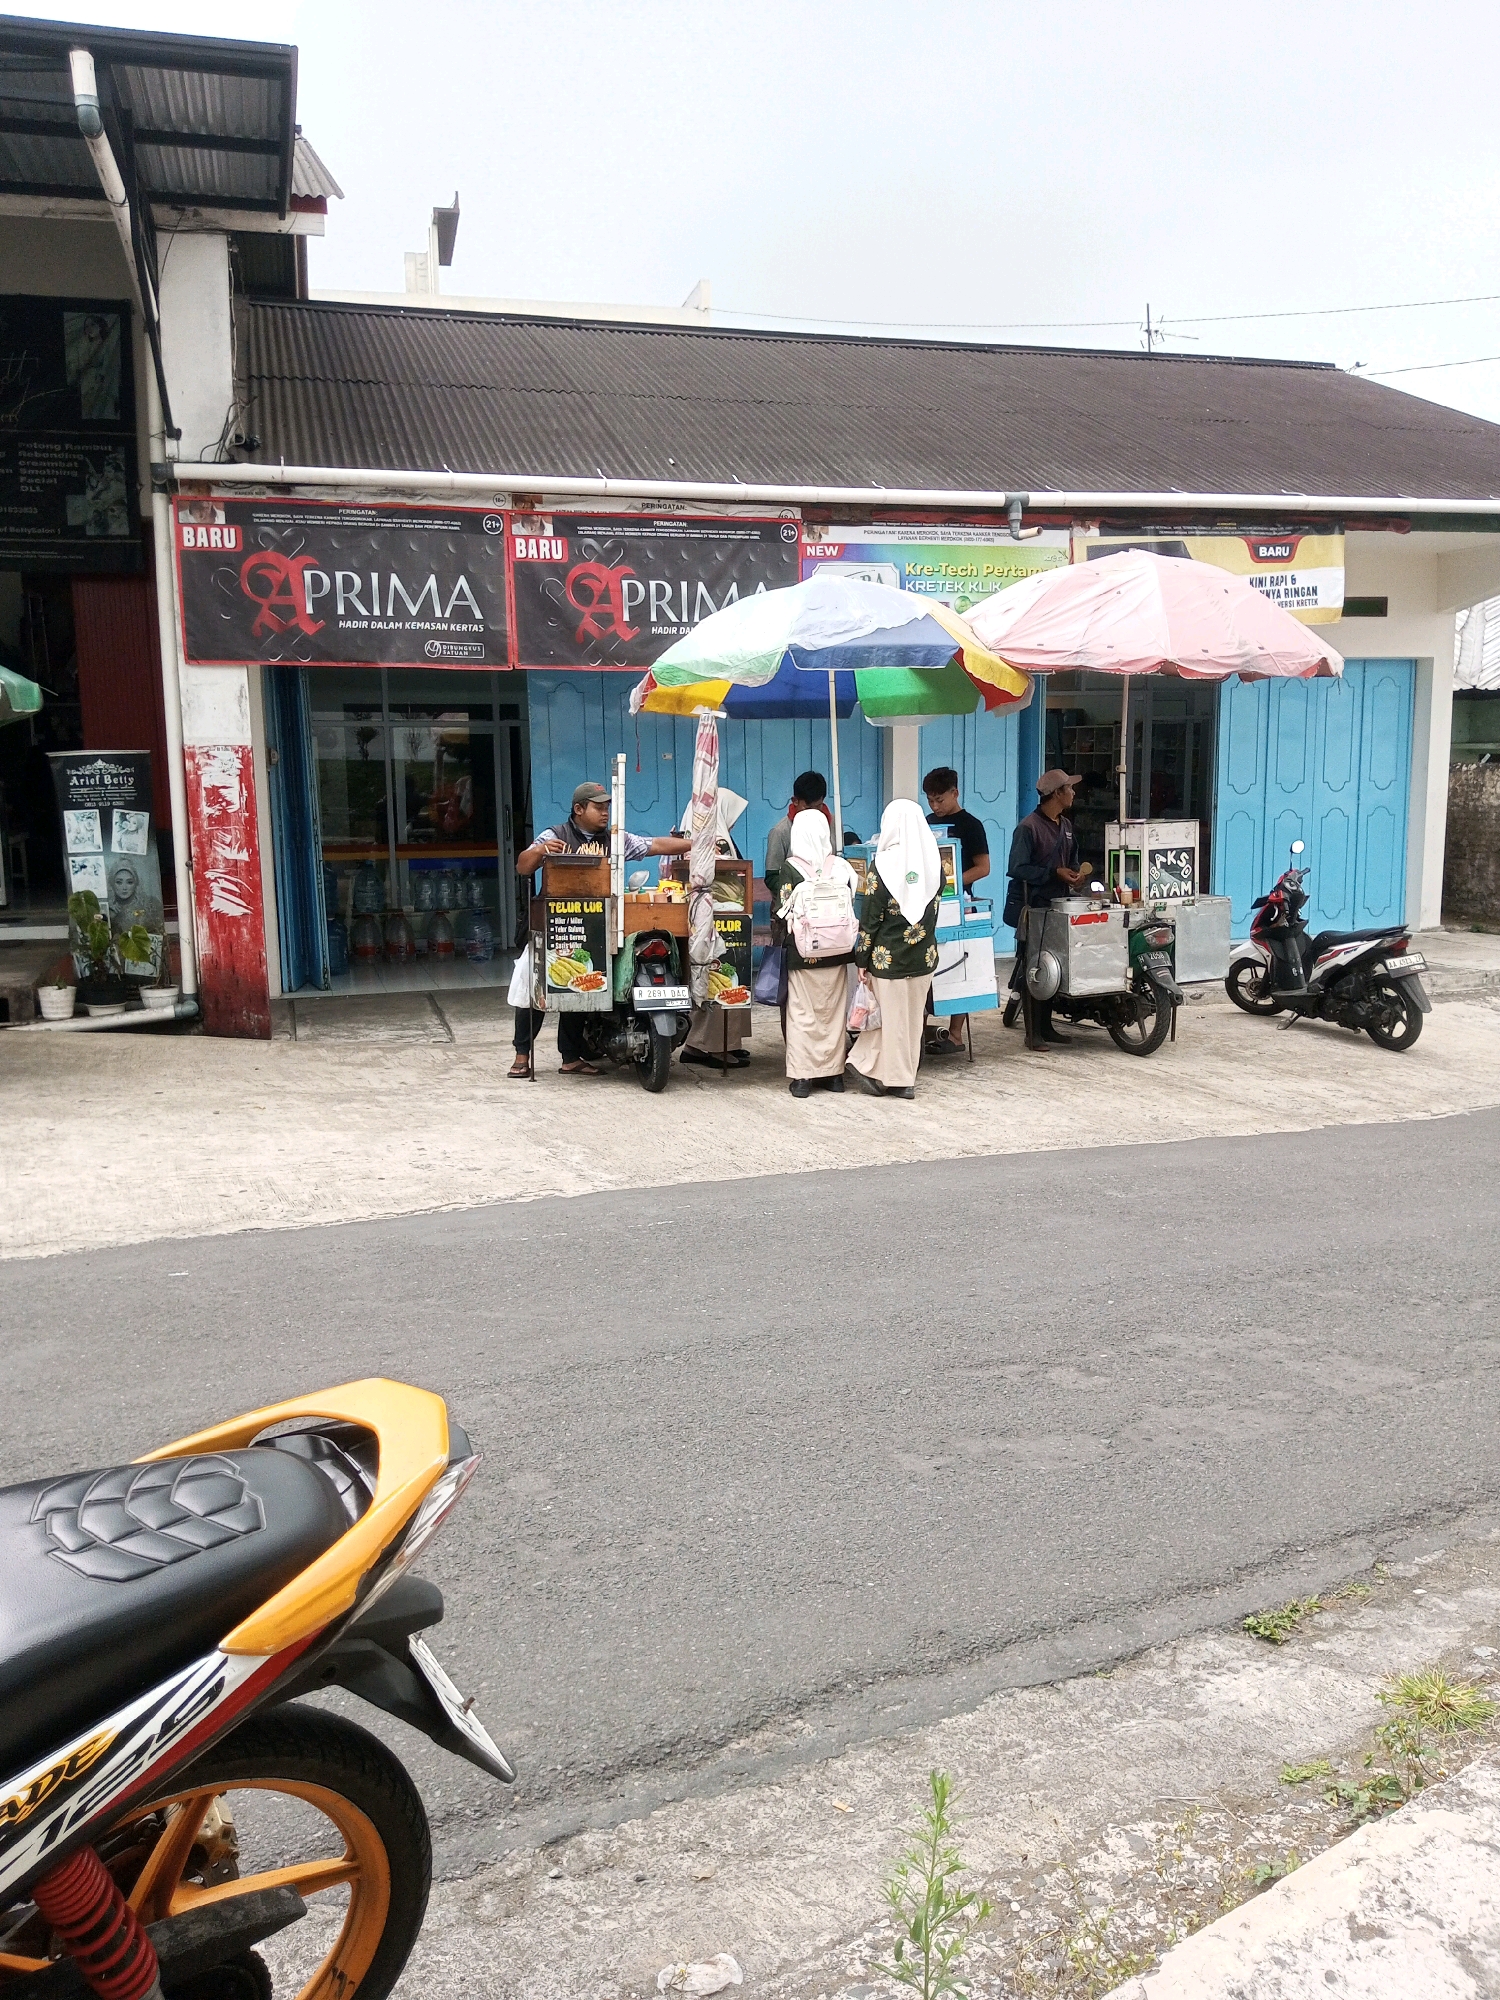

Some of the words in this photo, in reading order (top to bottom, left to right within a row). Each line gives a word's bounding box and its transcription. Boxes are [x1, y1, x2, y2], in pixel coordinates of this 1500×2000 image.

[485, 519, 501, 529] 21+
[182, 526, 237, 550] BARU
[782, 529, 796, 537] 21+
[515, 537, 563, 561] BARU
[806, 545, 839, 557] NEW
[1259, 545, 1290, 557] BARU
[905, 562, 978, 577] Kre-Tech
[983, 563, 1050, 577] Pertam
[905, 580, 965, 593] KRETEK
[968, 581, 1003, 593] KLIK
[1249, 576, 1267, 588] KINI
[1269, 574, 1288, 588] RAPI
[302, 569, 484, 620] PRIMA
[1284, 585, 1318, 599] RINGAN
[620, 579, 768, 623] PRIM
[338, 620, 368, 630] HADIR
[370, 620, 402, 631] DALAM
[404, 621, 448, 632] KEMASAN
[450, 623, 484, 633] KERTAS
[651, 626, 678, 635] HADIR
[104, 774, 135, 786] Betty
[1149, 849, 1193, 881] BAKSO
[1149, 880, 1193, 899] AYAM
[548, 901, 582, 914] TELUR
[583, 901, 604, 913] LUR
[713, 919, 743, 932] ELOR
[1388, 960, 1398, 969] AA
[638, 989, 643, 998] R
[671, 989, 687, 998] DAC
